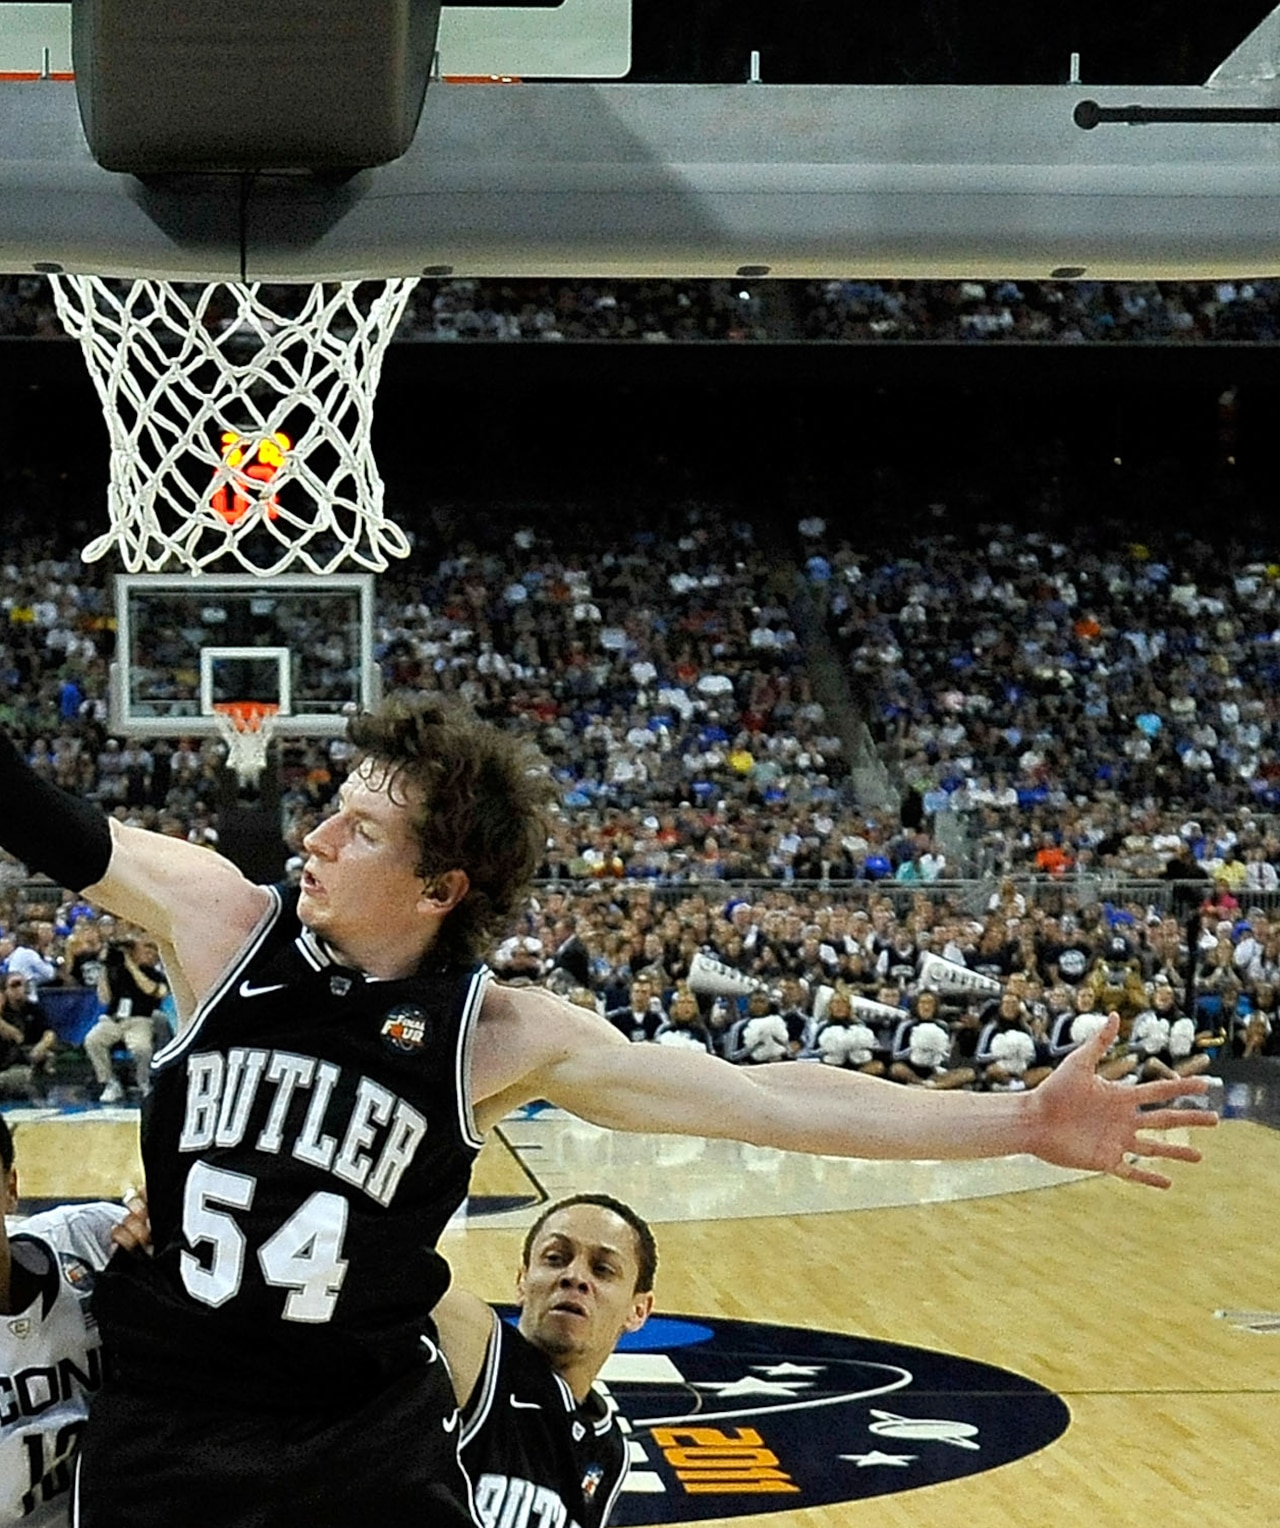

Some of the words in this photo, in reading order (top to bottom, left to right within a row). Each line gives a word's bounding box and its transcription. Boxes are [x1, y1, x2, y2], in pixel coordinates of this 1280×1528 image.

[178, 1047, 427, 1207] BUTLER
[179, 1159, 349, 1324] 54
[650, 1427, 802, 1494] 2011
